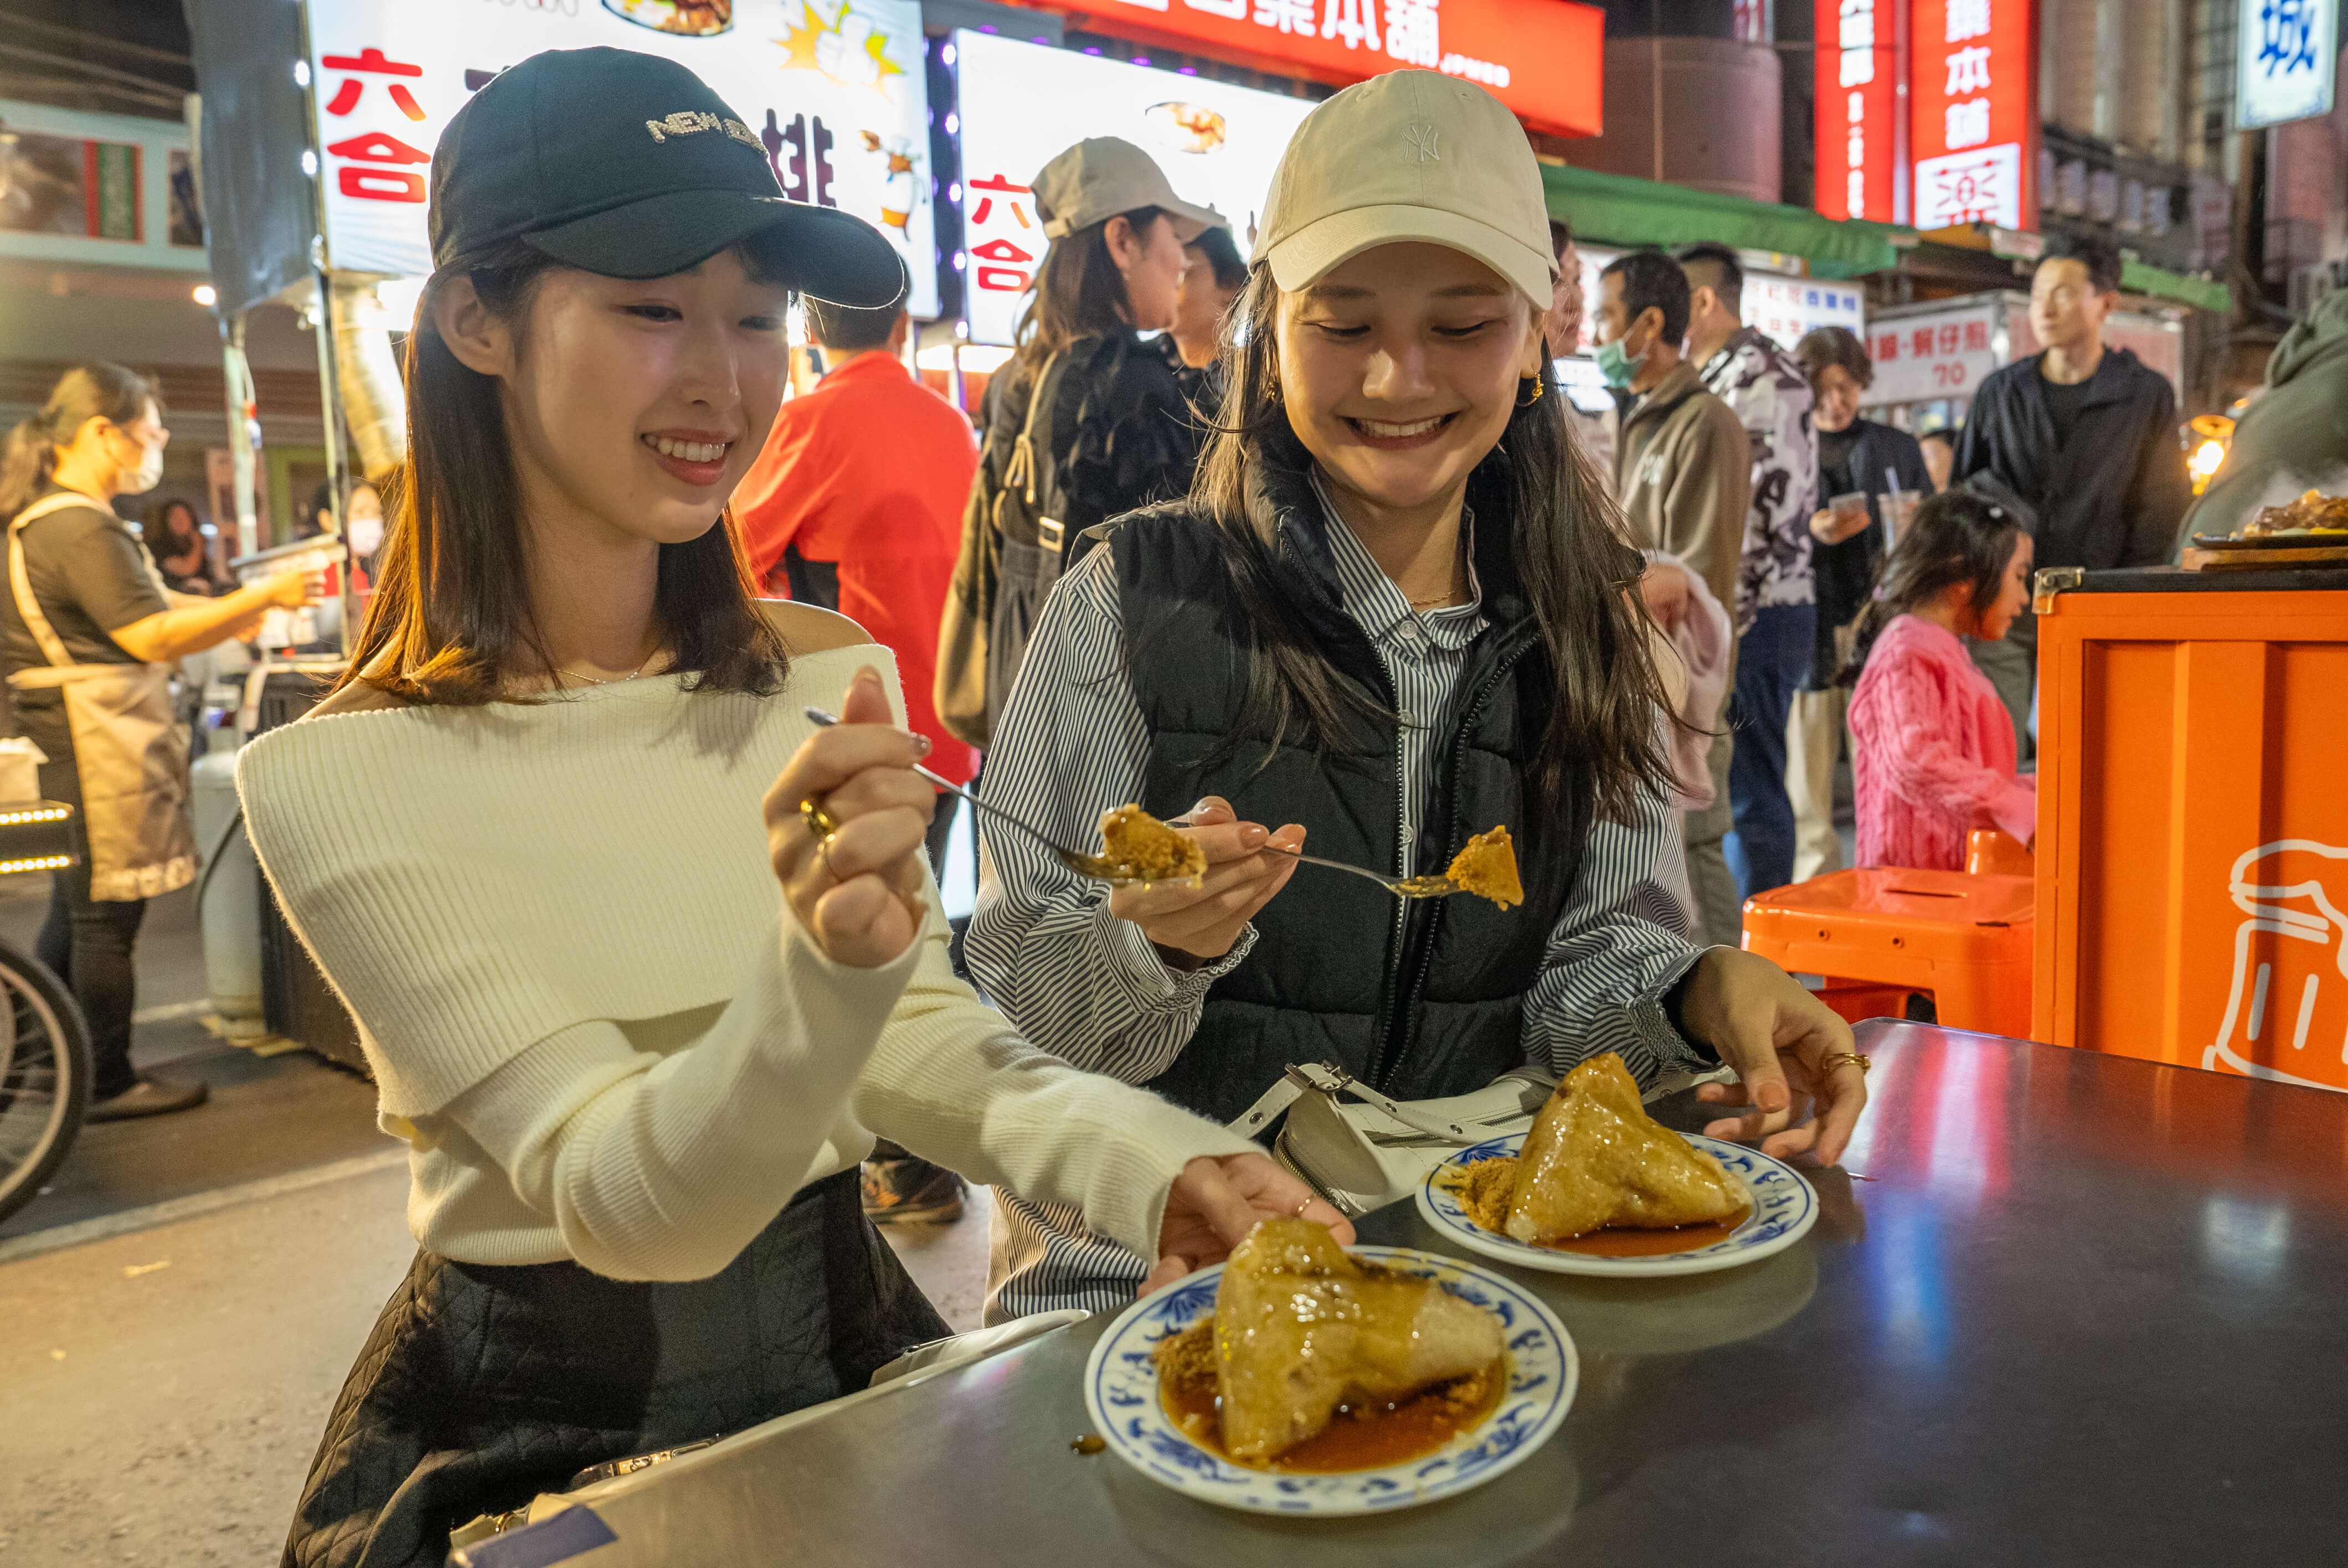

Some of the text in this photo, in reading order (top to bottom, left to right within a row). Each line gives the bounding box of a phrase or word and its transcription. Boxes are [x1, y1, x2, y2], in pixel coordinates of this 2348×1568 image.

[322, 48, 431, 203] 六合
[646, 111, 722, 143] NEW
[1399, 125, 1440, 163] NY
[969, 174, 1033, 292] 六合
[1933, 360, 1966, 386] 70
